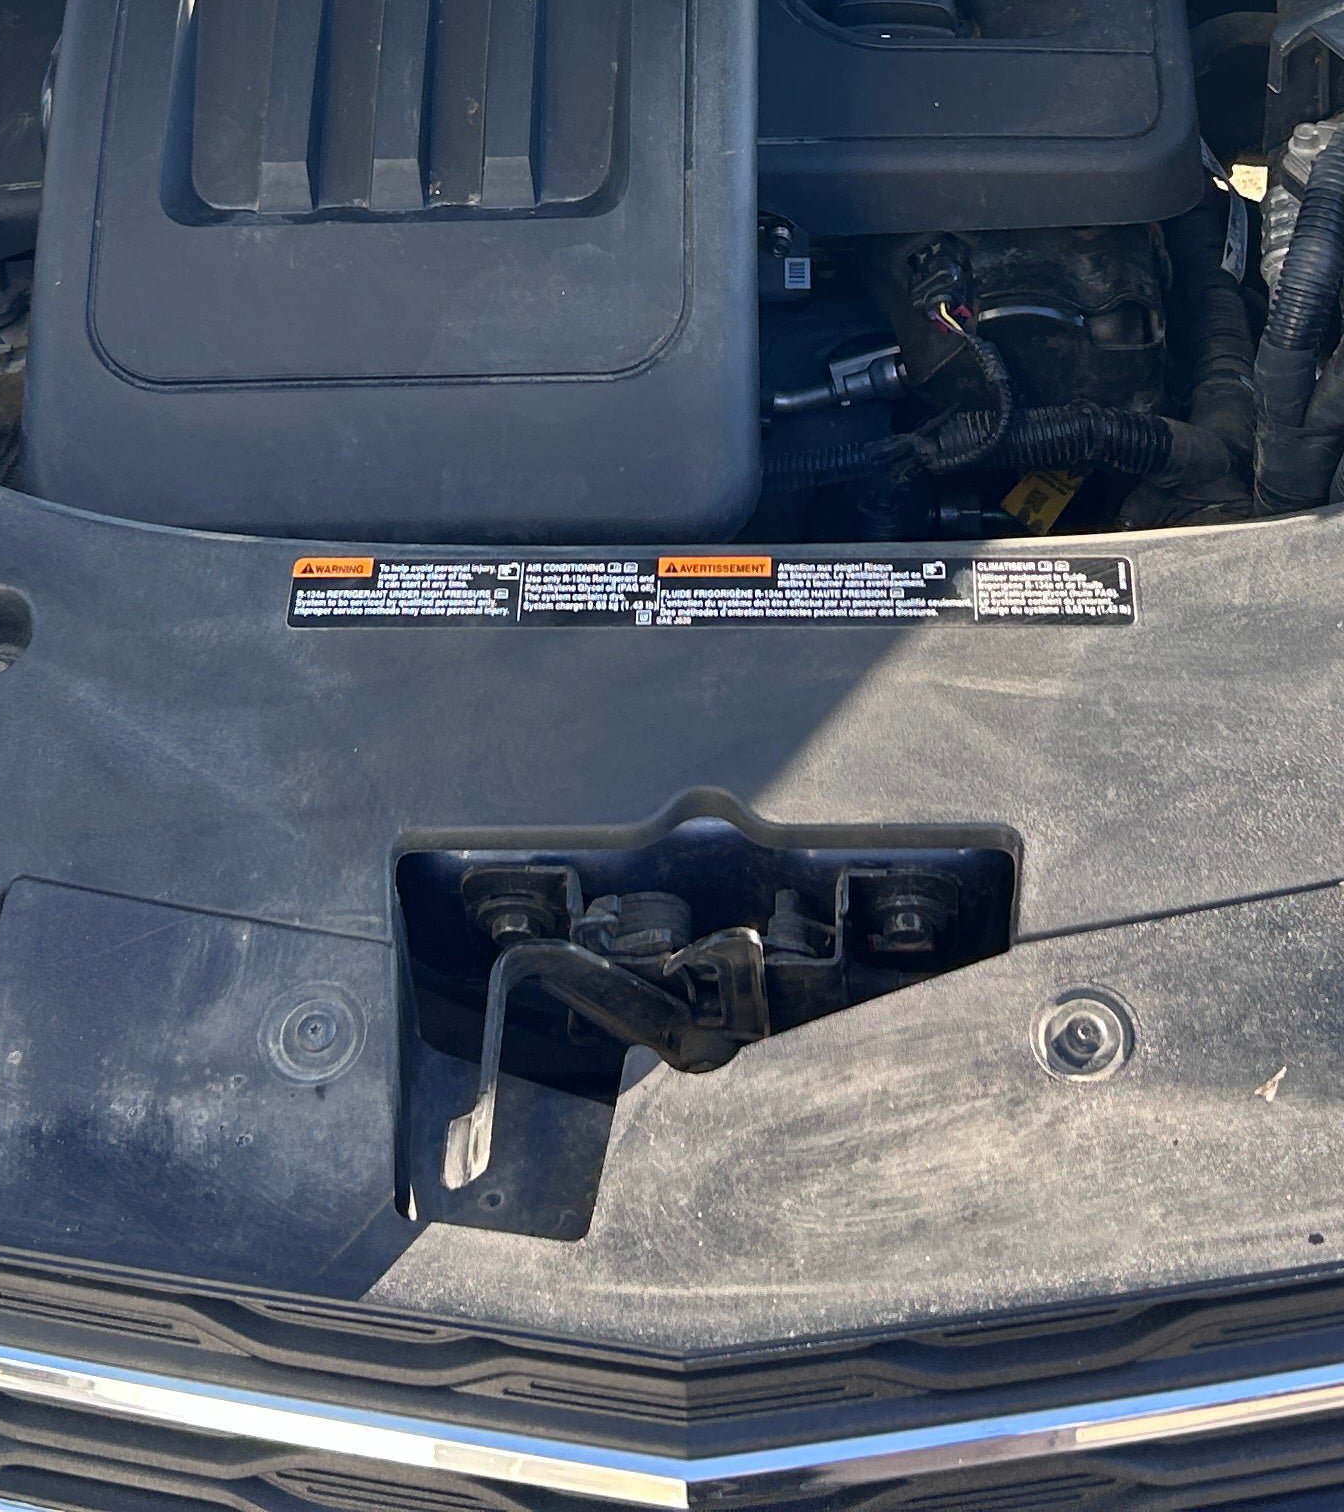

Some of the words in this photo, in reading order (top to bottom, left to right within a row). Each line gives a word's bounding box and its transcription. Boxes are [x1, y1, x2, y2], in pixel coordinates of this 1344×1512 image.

[315, 565, 364, 574] WARNING
[379, 564, 390, 573] To
[391, 564, 409, 574] help
[410, 564, 434, 573] avoid
[434, 564, 470, 574] personal
[526, 563, 541, 572] AIR
[543, 563, 605, 572] CONDITIONING
[679, 564, 766, 573] AVERTISSEMENT
[976, 561, 1036, 572] CLIMATISEUR
[399, 572, 425, 580] hands
[426, 572, 447, 580] clear
[526, 574, 541, 583] Use
[543, 574, 562, 584] only
[639, 574, 655, 583] and
[326, 590, 387, 599] REFRIGERANT
[388, 590, 420, 599] UNDER
[420, 590, 443, 599] HIGH
[444, 590, 491, 599] PRESSURE
[660, 589, 692, 599] FLUIDE
[784, 589, 810, 599] SOUS
[811, 589, 842, 599] HAUTE
[842, 589, 888, 599] PRESSION
[296, 599, 326, 608] System
[350, 599, 386, 607] serviced
[398, 599, 434, 608] qualified
[435, 599, 477, 608] personnel
[332, 607, 363, 615] service
[401, 607, 420, 616] may
[420, 607, 446, 615] cause
[446, 607, 483, 616] personal
